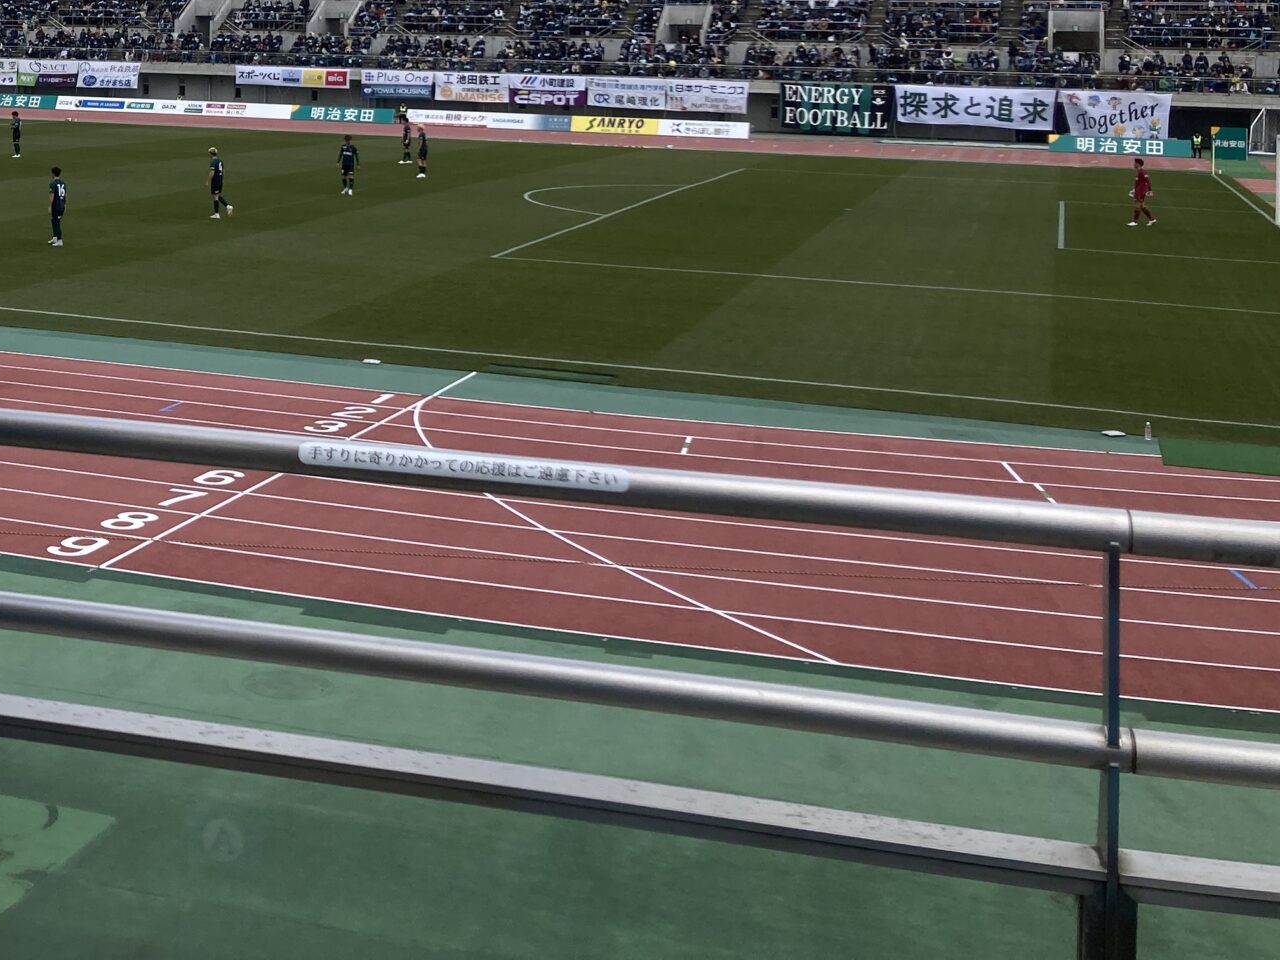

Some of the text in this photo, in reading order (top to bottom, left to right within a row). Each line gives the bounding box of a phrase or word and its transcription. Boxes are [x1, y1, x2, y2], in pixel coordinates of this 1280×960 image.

[41, 62, 68, 71] SACT
[238, 70, 280, 81] スポーツくじ
[376, 71, 430, 83] Plus One
[456, 73, 501, 86] 池田鉄工
[539, 77, 575, 88] 小町建設
[395, 88, 430, 96] HOUSING
[675, 83, 745, 95] 日本サーモニクス
[783, 83, 864, 106] ENERGY
[456, 91, 505, 102] IMARISE
[310, 106, 374, 122] 明治安田
[899, 90, 1050, 125] 探求と追求
[585, 117, 645, 132] SANRYO
[783, 105, 888, 130] FOOTBALL
[1075, 100, 1160, 135] Together
[1076, 137, 1165, 155] 明治安田
[56, 183, 66, 197] 16
[370, 393, 395, 405] 1
[330, 406, 377, 420] 2
[303, 419, 349, 433] 3
[307, 445, 620, 486] 手すりに寄りかかっての応援はご遠慮下さい
[192, 469, 246, 486] 6
[157, 487, 209, 507] 7
[99, 510, 160, 531] 8
[46, 535, 110, 558] 9
